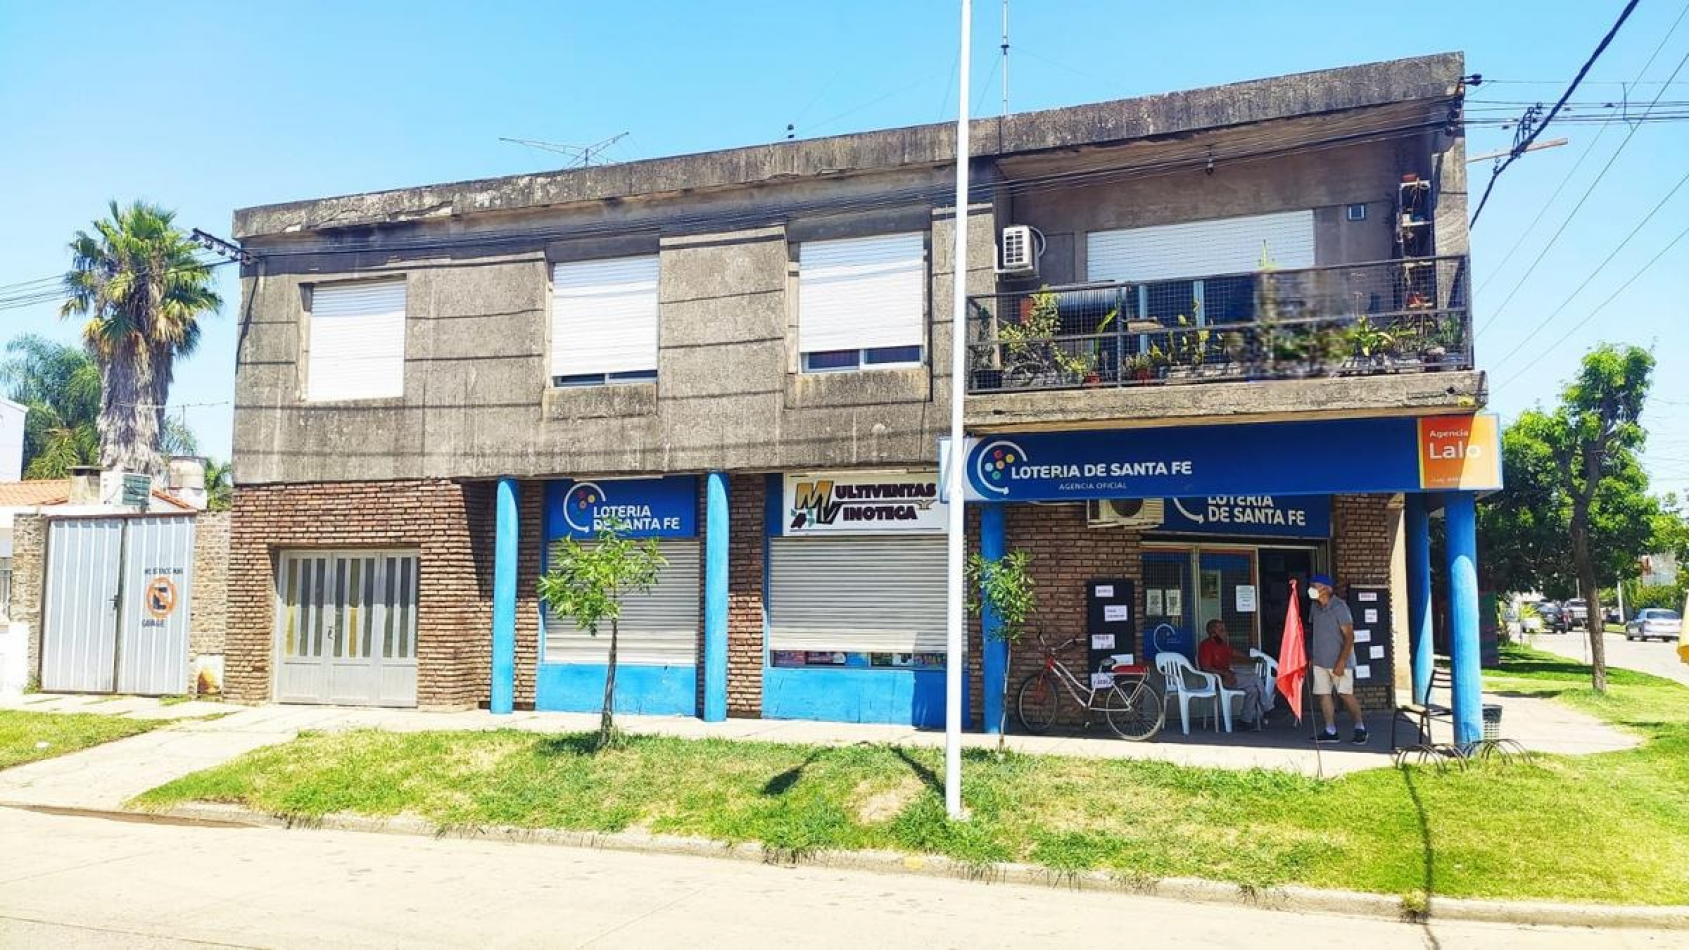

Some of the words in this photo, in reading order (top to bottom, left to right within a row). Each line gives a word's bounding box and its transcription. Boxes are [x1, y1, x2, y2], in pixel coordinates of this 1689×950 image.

[1429, 428, 1469, 438] Agencia
[1429, 440, 1481, 460] Lalo
[1011, 465, 1081, 479] LOTERIA
[1084, 463, 1107, 477] DE
[1110, 462, 1168, 477] SANTA
[1171, 461, 1193, 475] FE
[1058, 483, 1095, 491] AGENCIA
[1096, 481, 1127, 490] OFICIAL
[593, 505, 651, 518] LOTERIA
[1208, 506, 1230, 522] DE
[1233, 507, 1285, 525] SANTA
[1287, 510, 1306, 525] FE
[663, 518, 681, 529] FE
